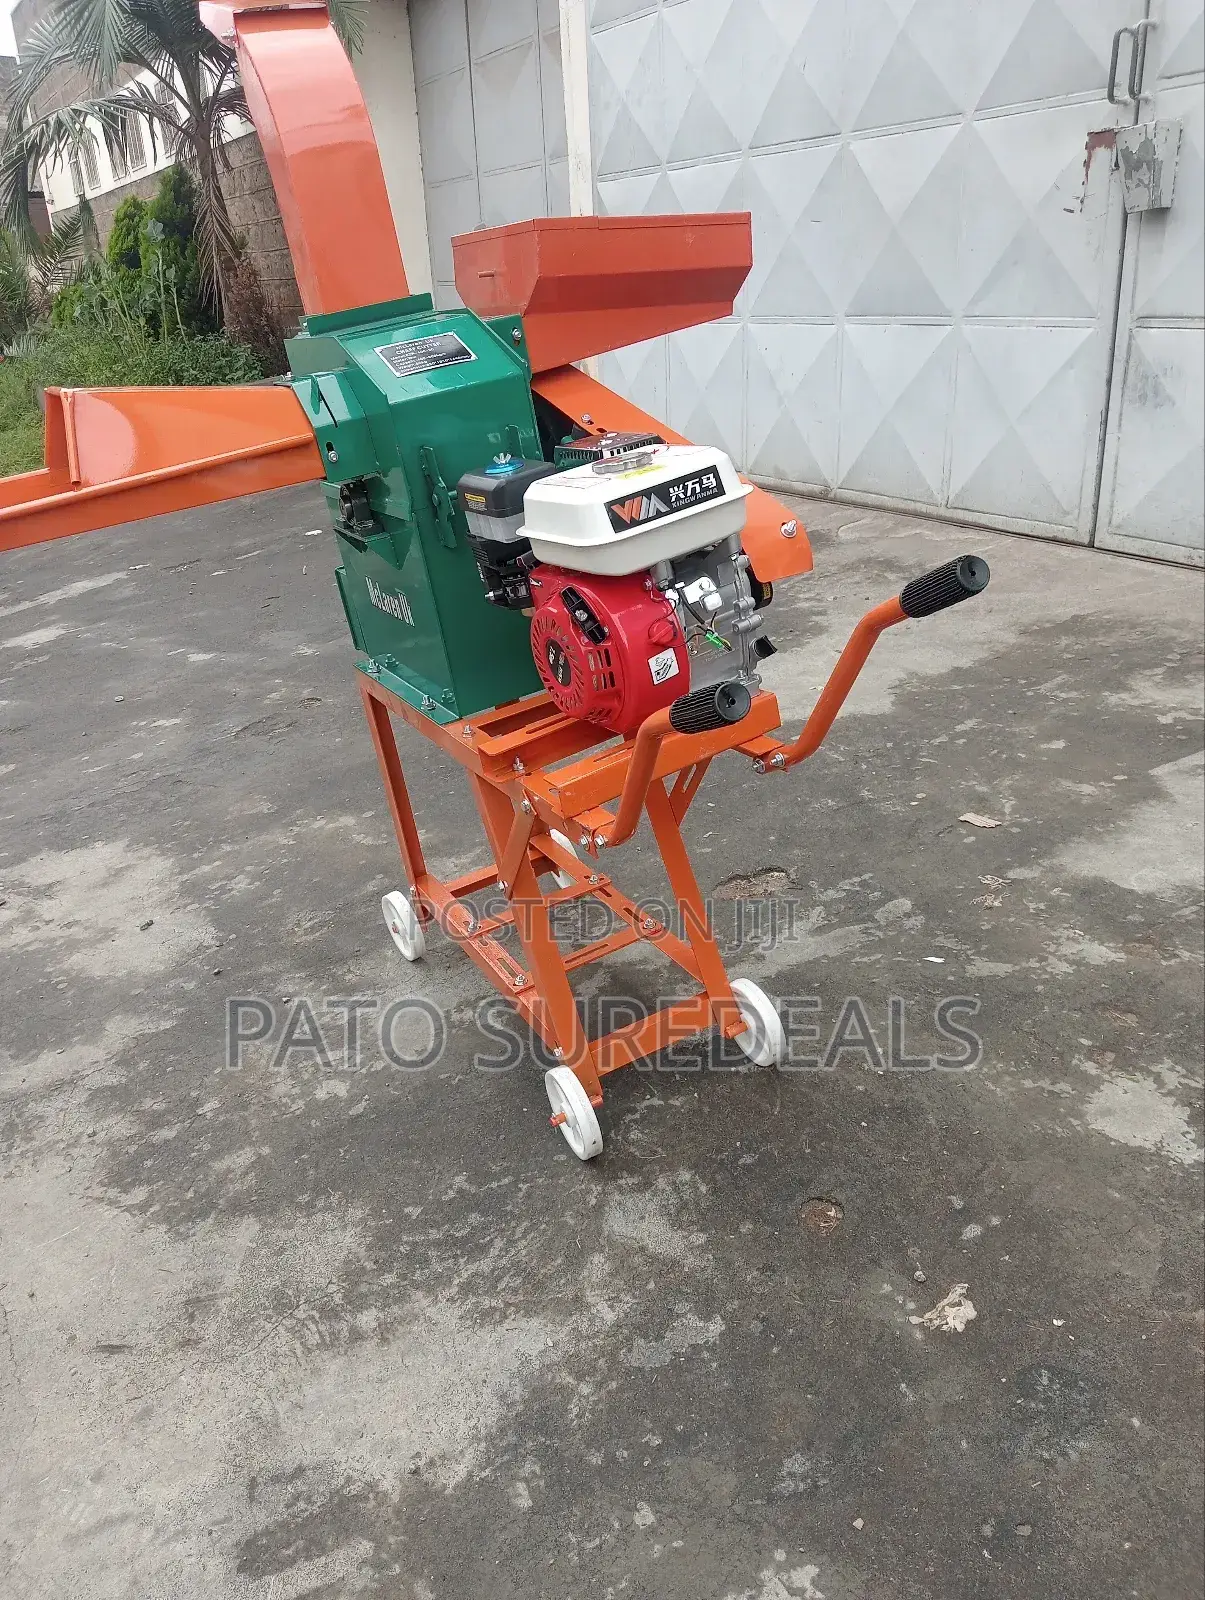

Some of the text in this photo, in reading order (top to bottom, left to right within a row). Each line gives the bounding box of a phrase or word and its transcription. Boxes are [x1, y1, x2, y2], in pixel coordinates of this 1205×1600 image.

[668, 472, 717, 502] 兴万马
[671, 487, 719, 508] XINGWANMA
